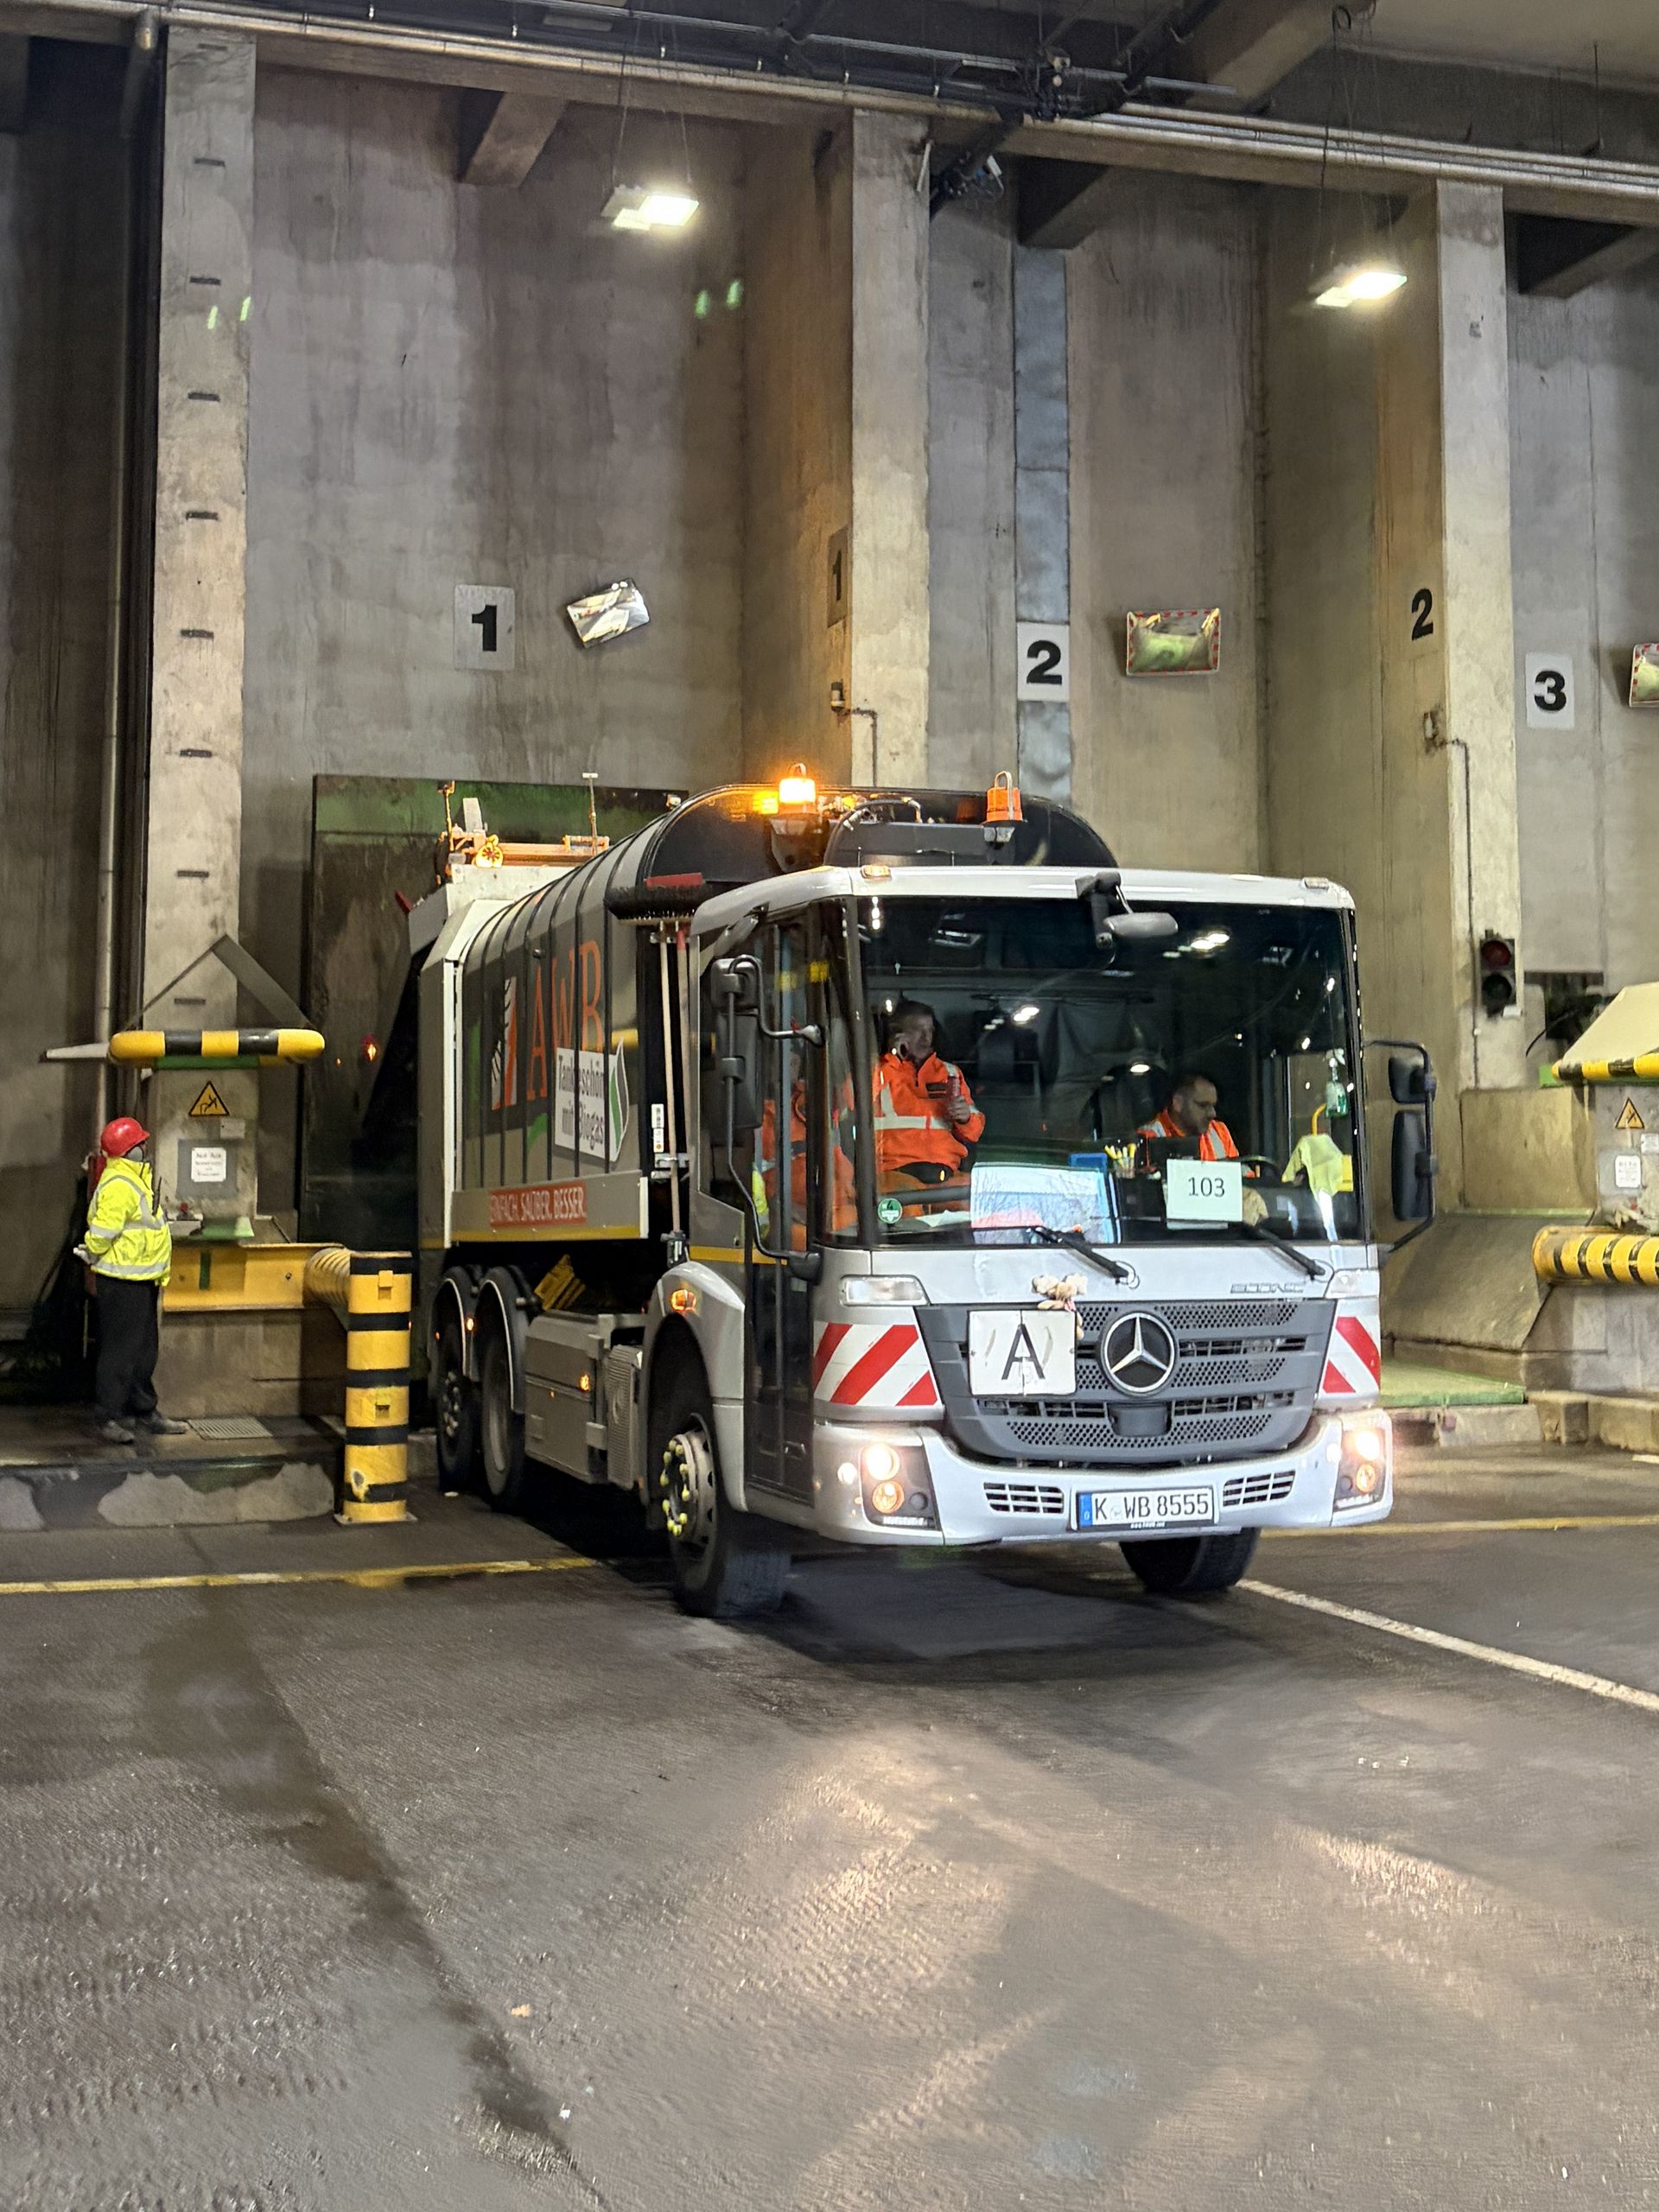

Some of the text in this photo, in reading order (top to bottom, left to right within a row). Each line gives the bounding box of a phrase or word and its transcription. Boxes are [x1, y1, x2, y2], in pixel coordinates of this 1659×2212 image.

[831, 550, 842, 601] 1
[472, 605, 497, 652] 1
[1412, 588, 1433, 641] 2
[1027, 640, 1063, 685] 2
[1534, 670, 1567, 712] 3
[527, 940, 602, 1102] AWB
[1188, 1177, 1225, 1198] 103
[1001, 1323, 1046, 1381] A
[1095, 1493, 1210, 1521] K WB 8555
